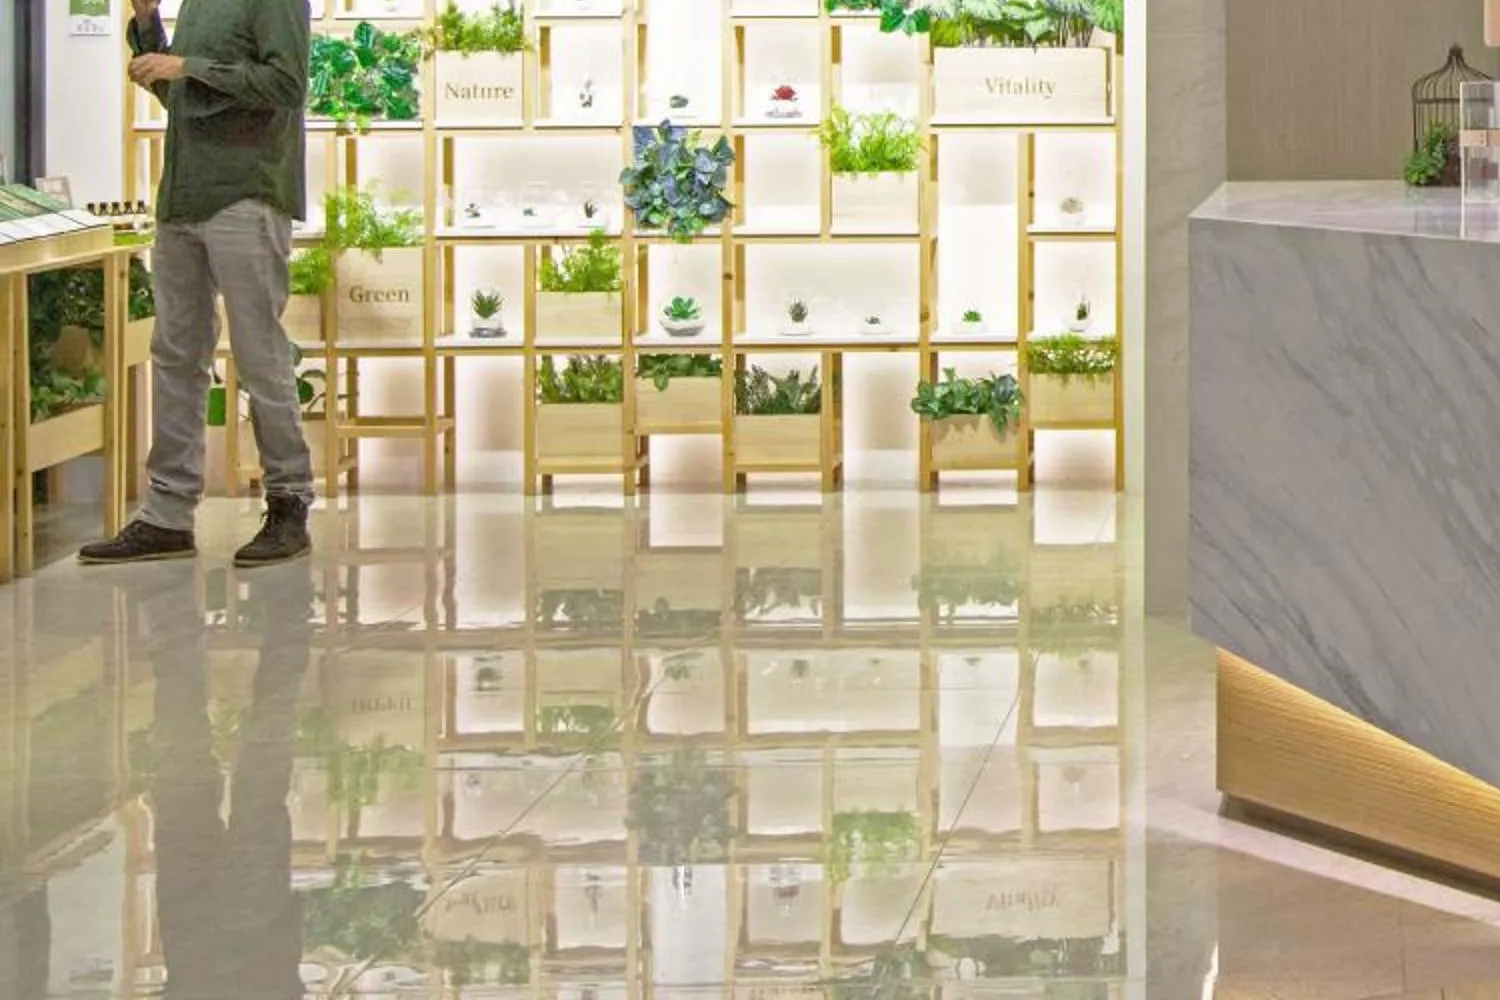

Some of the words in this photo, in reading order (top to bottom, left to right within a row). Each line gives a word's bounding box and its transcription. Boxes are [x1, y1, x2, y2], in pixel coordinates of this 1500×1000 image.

[445, 82, 513, 99] Nature
[985, 76, 1057, 99] Vitality
[349, 284, 409, 303] Green
